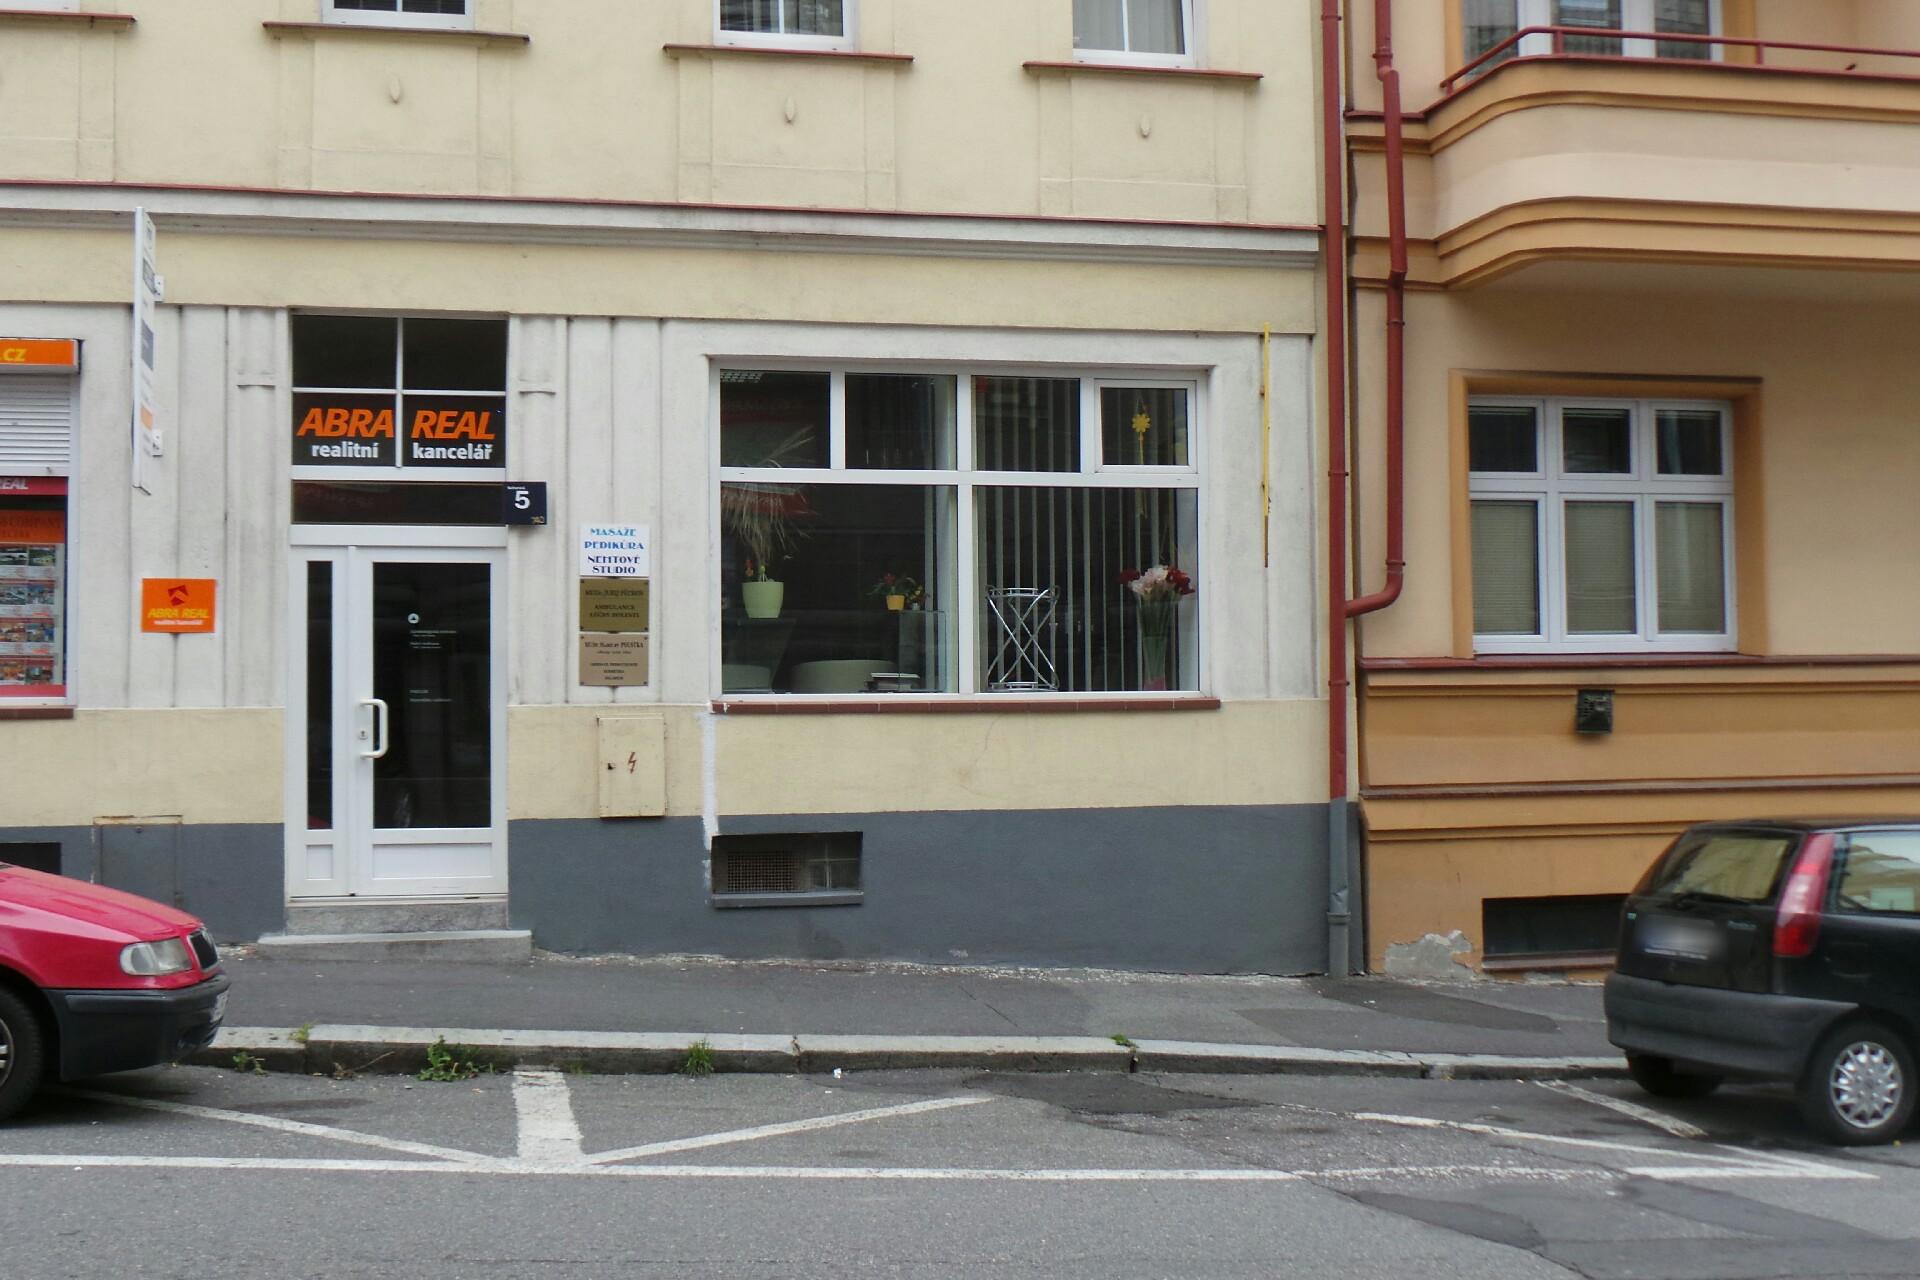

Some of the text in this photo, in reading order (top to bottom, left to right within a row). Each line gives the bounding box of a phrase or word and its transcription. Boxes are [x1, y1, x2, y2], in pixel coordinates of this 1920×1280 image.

[296, 407, 496, 440] ABRA REAL
[312, 441, 494, 460] realitní kancelář
[514, 490, 531, 510] 5
[592, 565, 636, 574] STUDIO
[147, 608, 179, 619] ABRA
